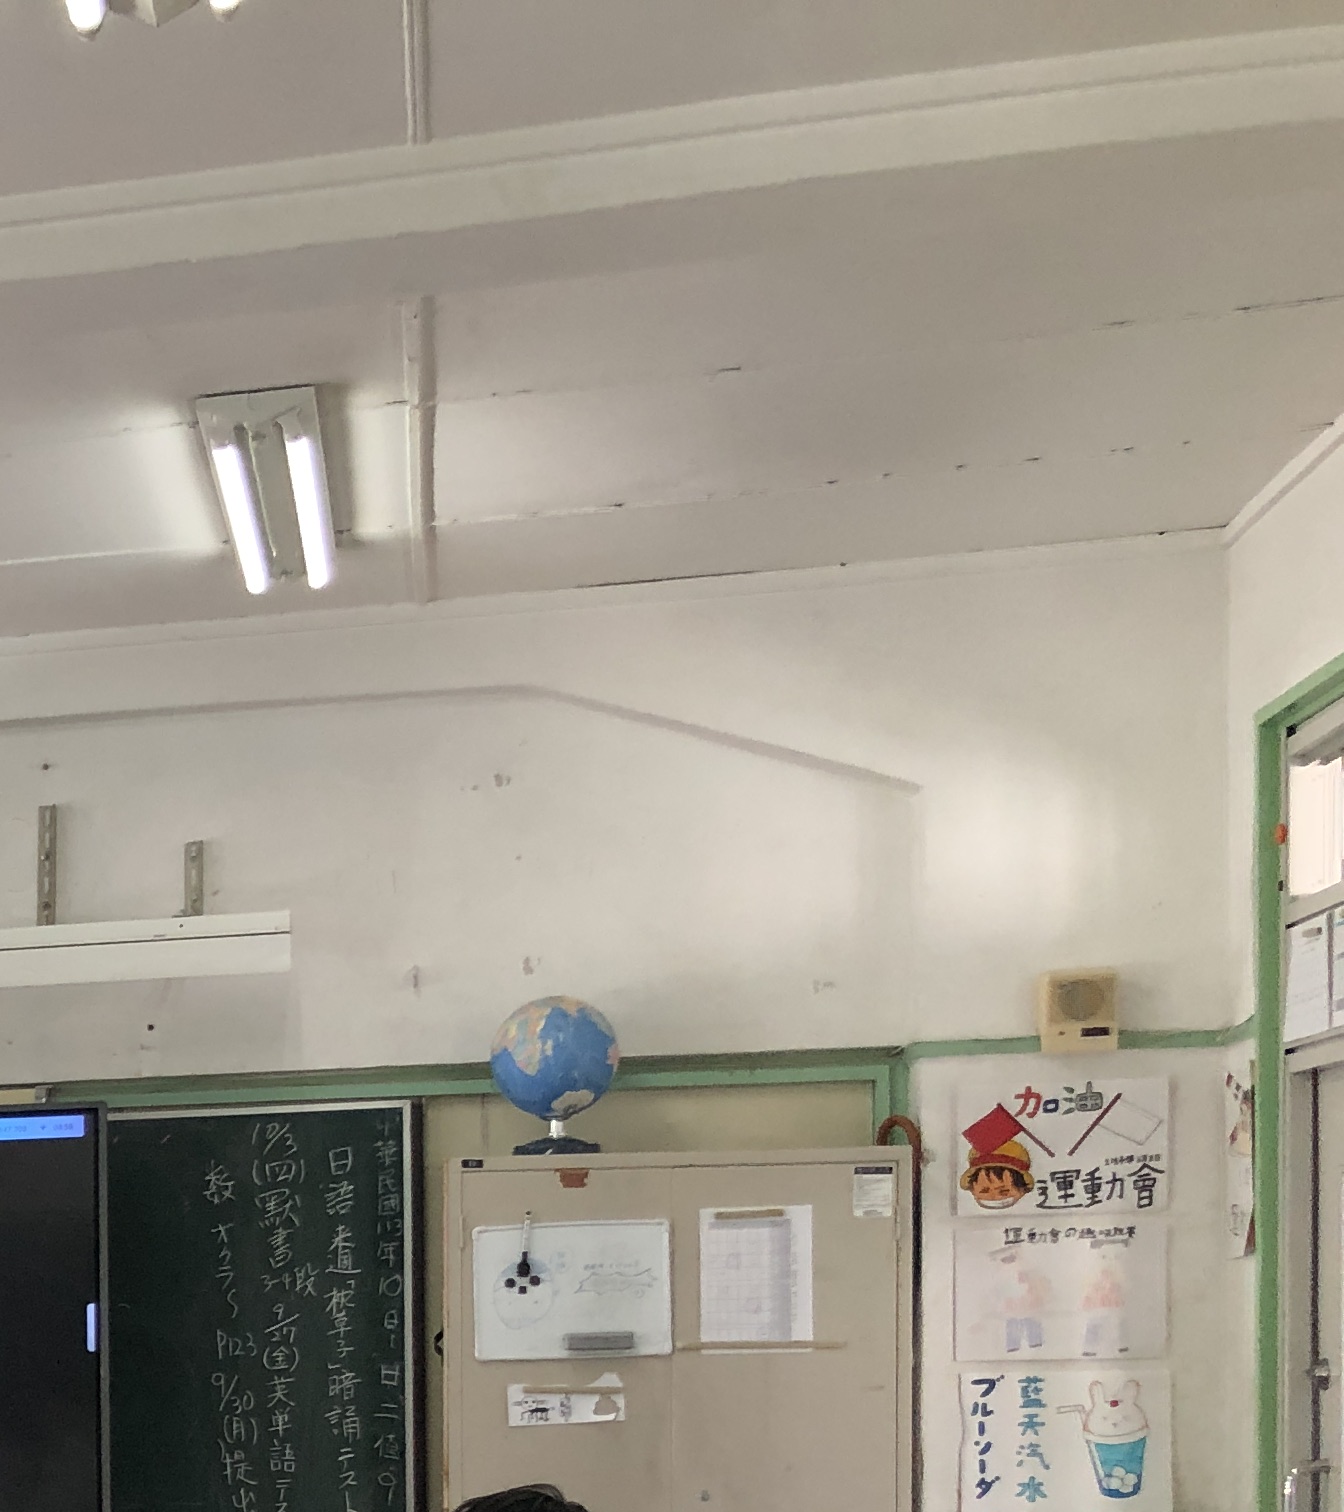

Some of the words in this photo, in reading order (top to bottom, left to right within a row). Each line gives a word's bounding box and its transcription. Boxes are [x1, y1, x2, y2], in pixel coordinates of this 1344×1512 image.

[1014, 1081, 1103, 1118] 加油
[1035, 1162, 1165, 1209] 運動會
[1014, 1376, 1050, 1502] 藍天汽水
